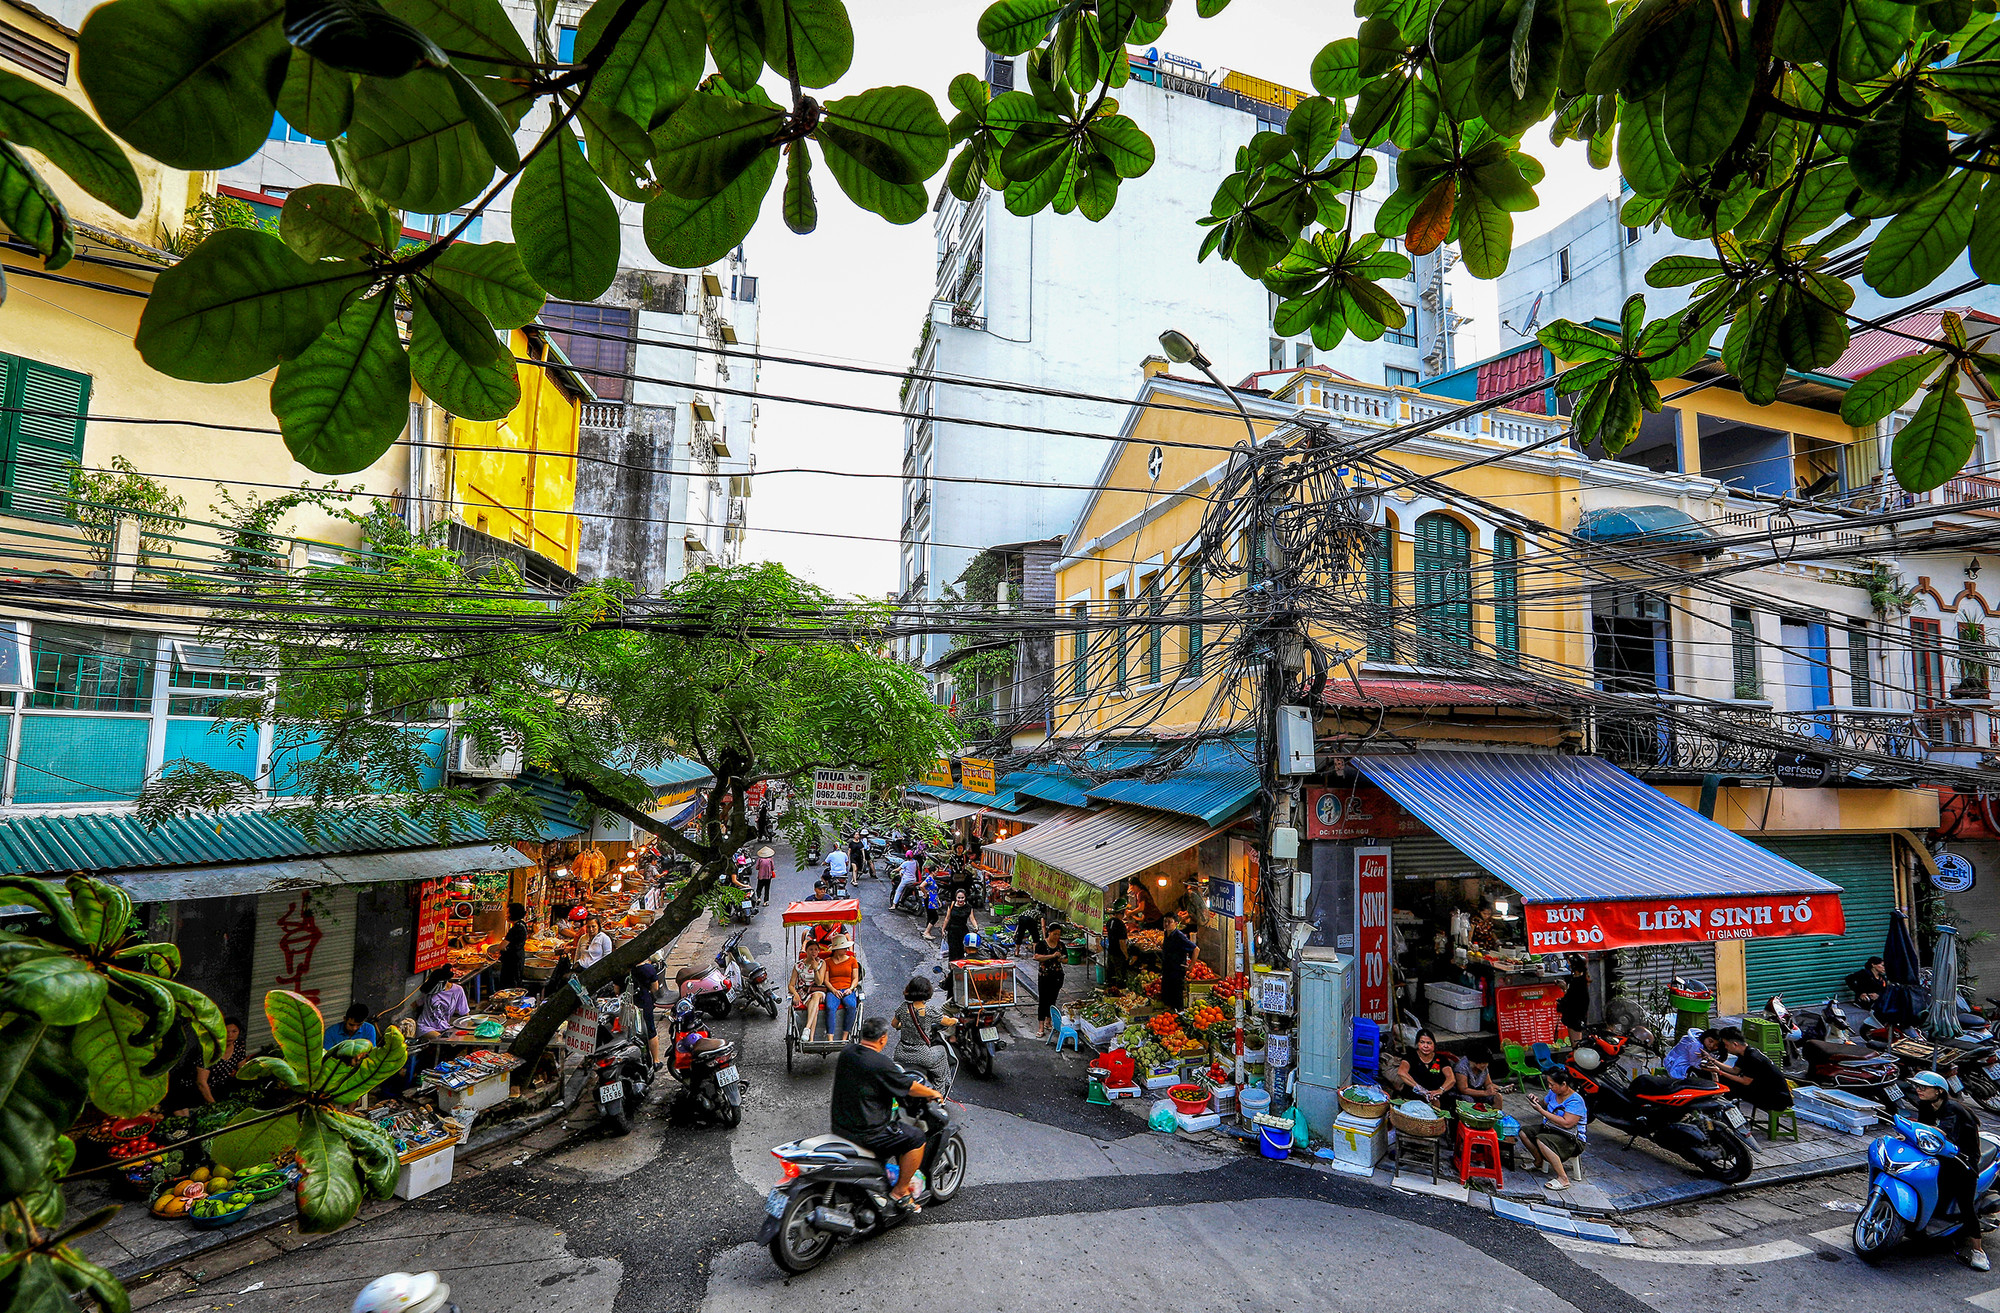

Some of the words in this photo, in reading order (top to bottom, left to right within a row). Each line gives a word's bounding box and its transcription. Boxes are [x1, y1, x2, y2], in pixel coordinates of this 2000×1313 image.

[817, 771, 845, 782] MUA
[1778, 765, 1822, 776] perfetto
[817, 780, 834, 790] BÀN
[1362, 859, 1384, 878] Liên
[1938, 867, 1967, 878] arett
[1362, 892, 1385, 928] SINH
[1546, 904, 1585, 923] BÚN
[1638, 905, 1702, 930] LIÊN
[1710, 905, 1773, 927] SINH
[1778, 897, 1812, 923] TỐ
[1532, 926, 1572, 946] PHÚ
[1576, 925, 1604, 944] ĐÔ
[1706, 930, 1715, 939] 17
[1718, 929, 1733, 939] GIA
[1365, 934, 1383, 988] TỐ
[1369, 999, 1380, 1009] 17
